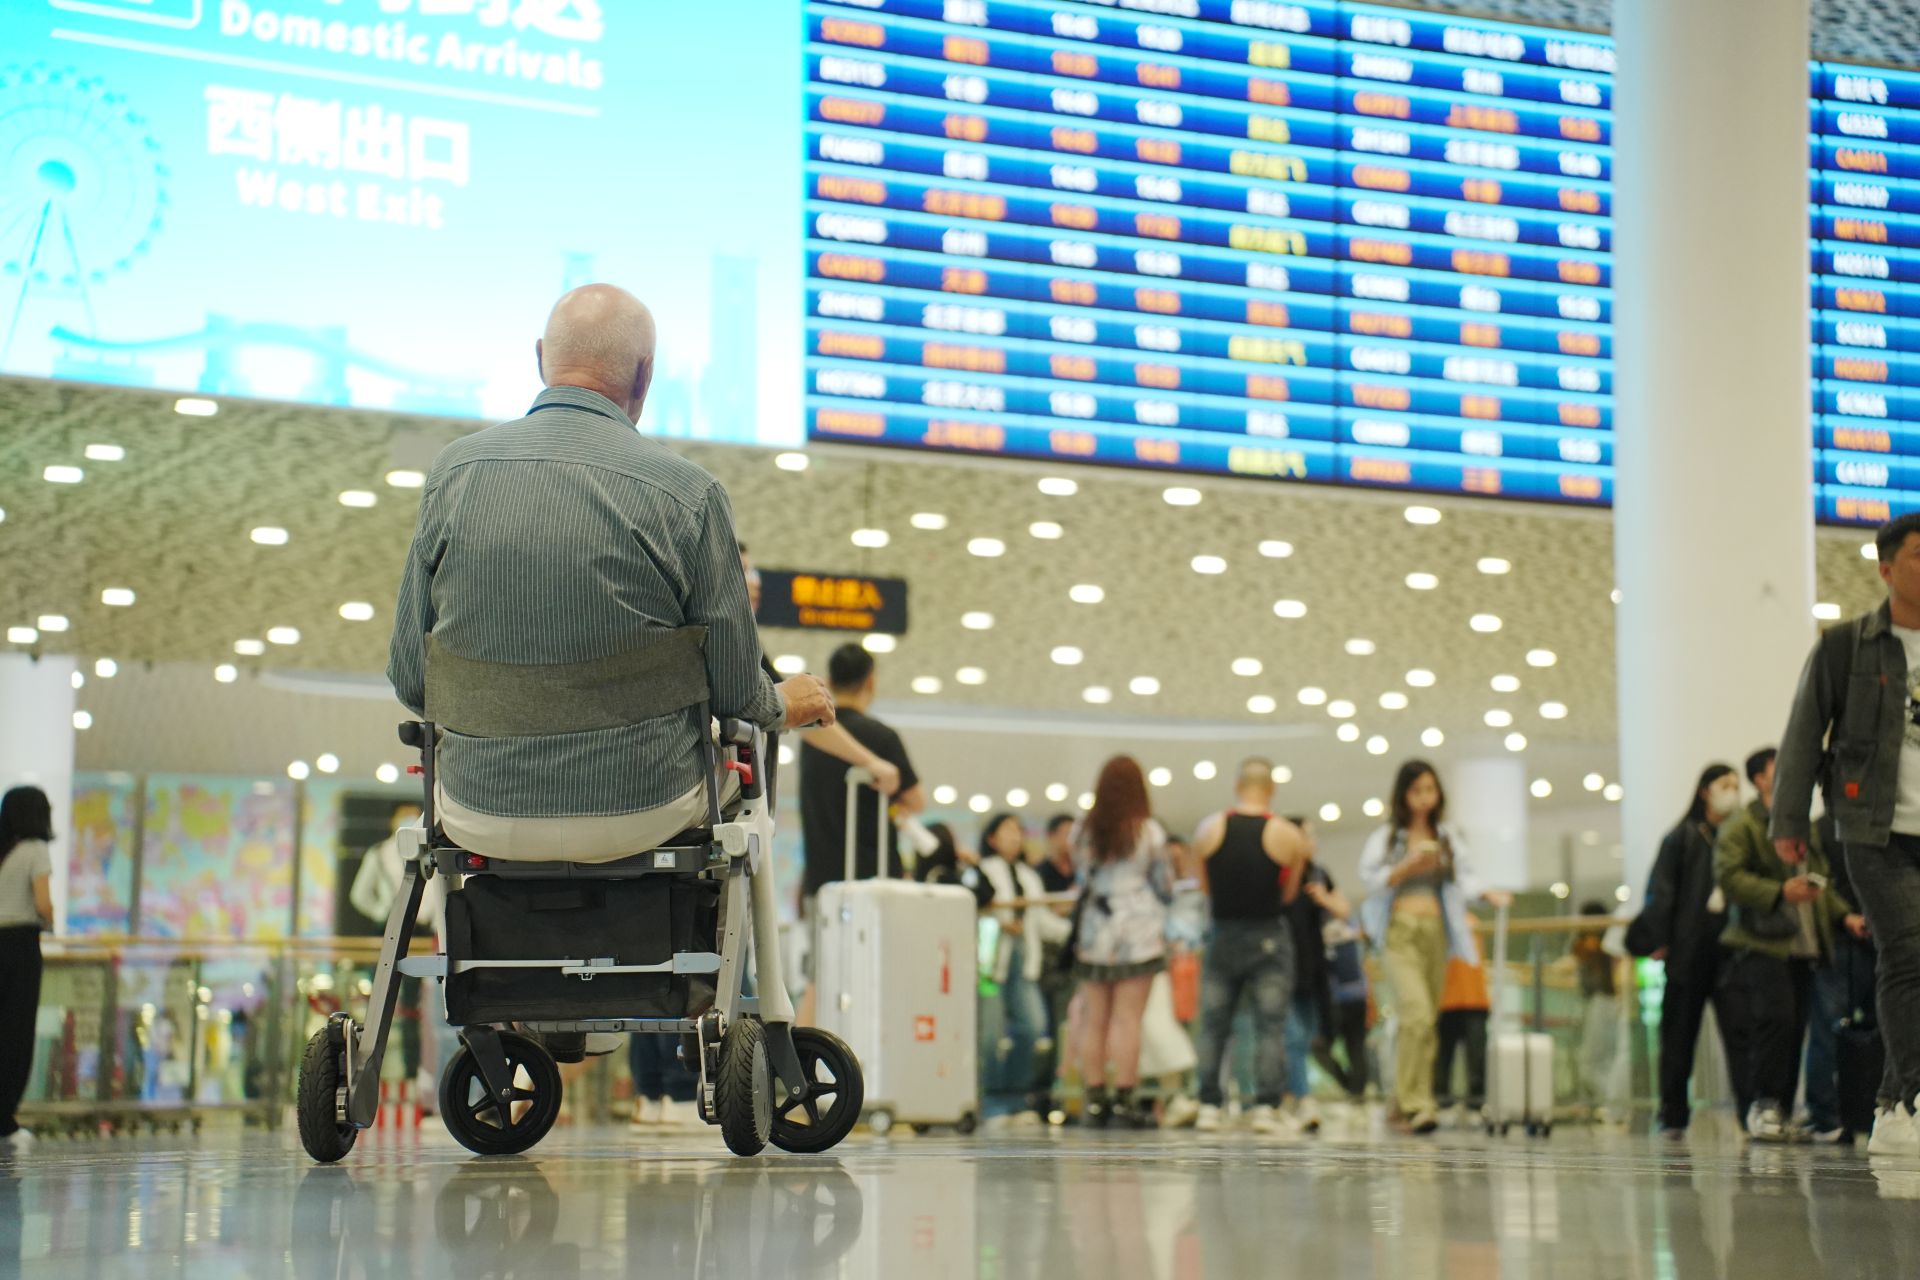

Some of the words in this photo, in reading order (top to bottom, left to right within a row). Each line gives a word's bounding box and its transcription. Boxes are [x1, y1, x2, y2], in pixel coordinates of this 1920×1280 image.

[219, 0, 430, 64] Domestic
[435, 32, 604, 91] Arrivals
[204, 84, 470, 187] 西侧出口
[235, 167, 347, 217] West
[355, 182, 445, 230] Exit
